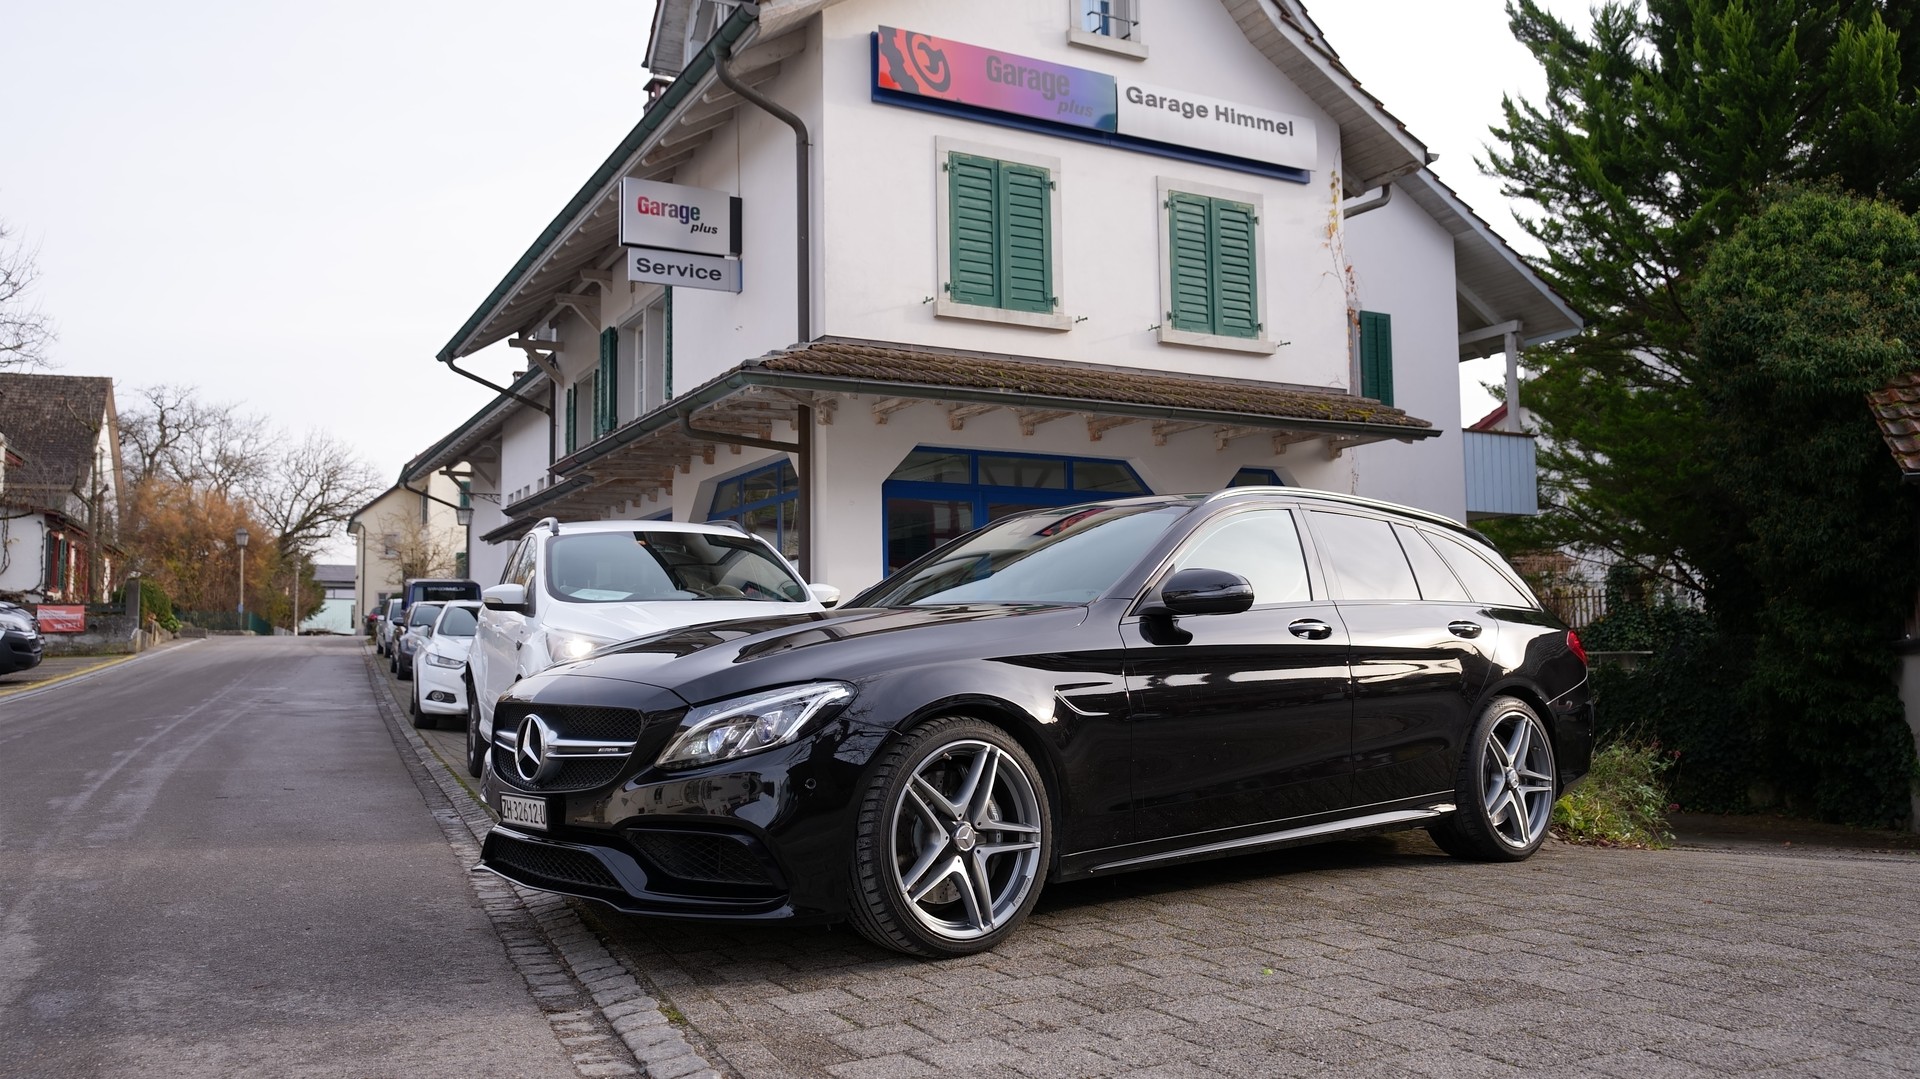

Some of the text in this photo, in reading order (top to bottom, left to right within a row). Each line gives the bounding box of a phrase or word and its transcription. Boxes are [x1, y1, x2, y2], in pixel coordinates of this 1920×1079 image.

[985, 55, 1070, 101] Garage
[1057, 100, 1094, 118] plus
[1126, 86, 1294, 136] Garage Himmel
[637, 196, 701, 225] Garage
[690, 223, 718, 234] plus
[636, 257, 722, 281] Service
